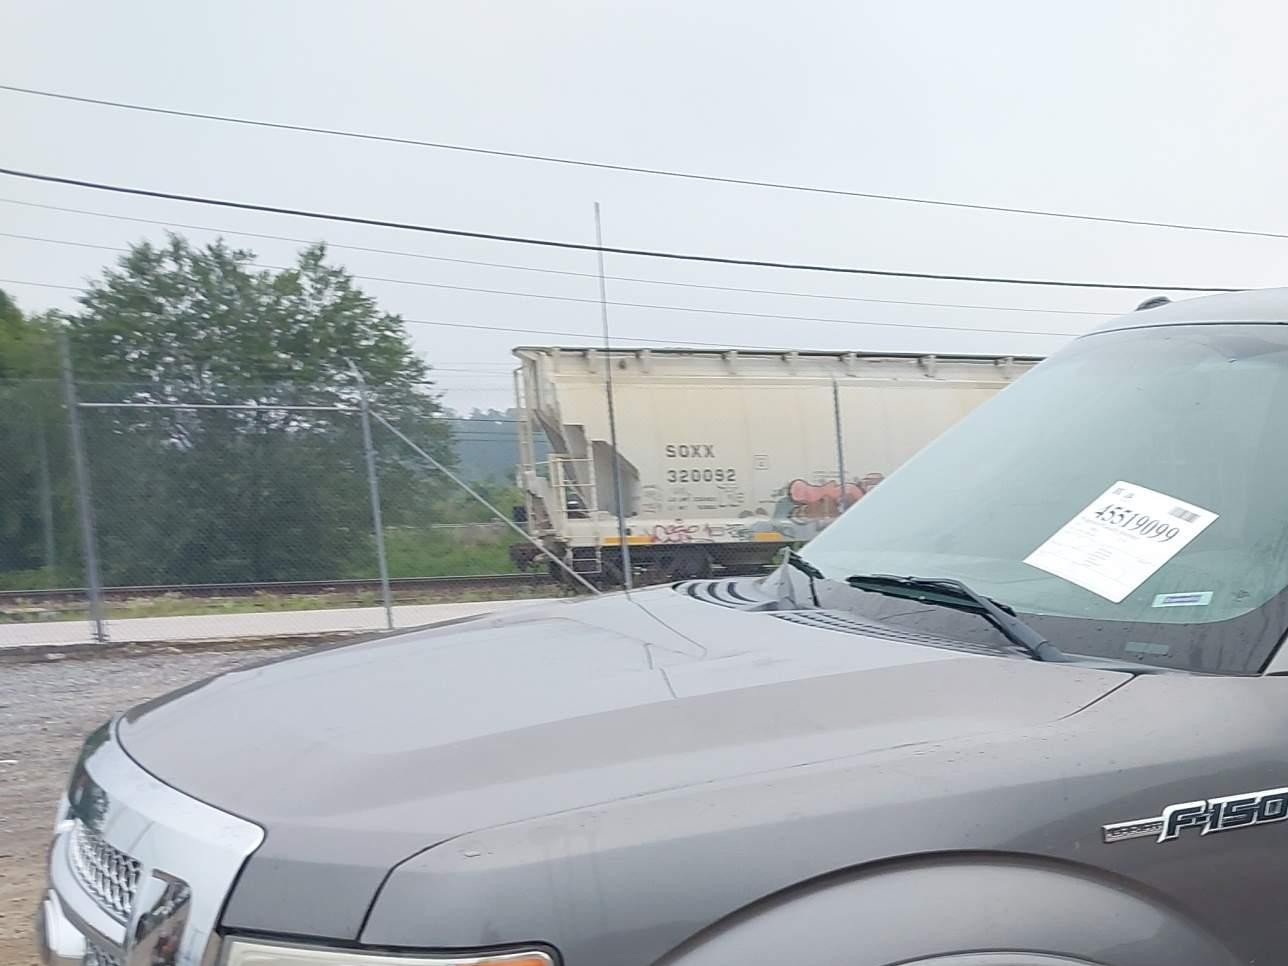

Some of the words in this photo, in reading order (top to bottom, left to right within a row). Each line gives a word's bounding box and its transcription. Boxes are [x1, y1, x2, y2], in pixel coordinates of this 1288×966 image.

[665, 444, 716, 458] SOXX
[666, 468, 737, 483] 320092
[1094, 503, 1181, 543] 45519099
